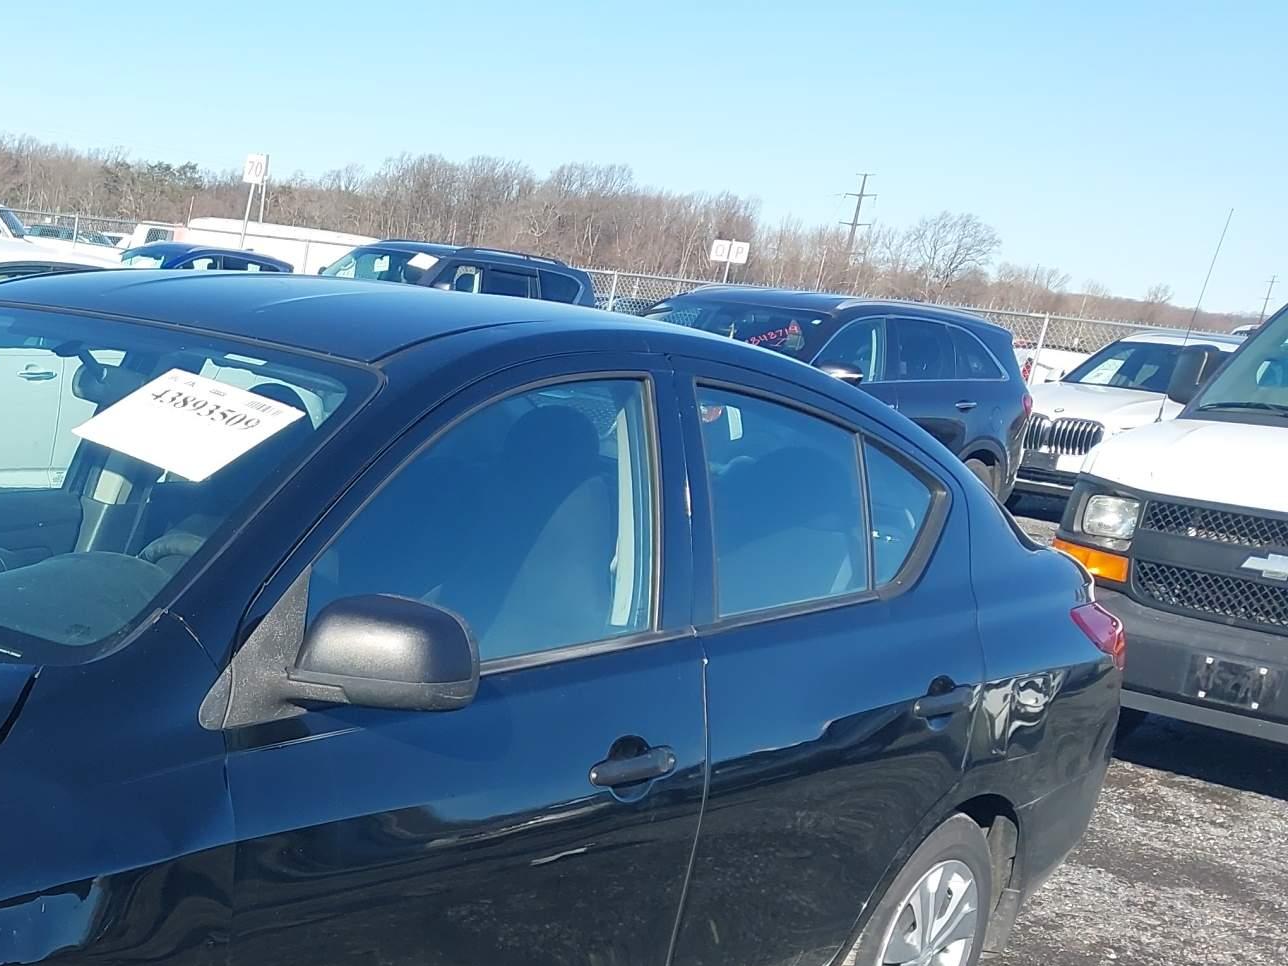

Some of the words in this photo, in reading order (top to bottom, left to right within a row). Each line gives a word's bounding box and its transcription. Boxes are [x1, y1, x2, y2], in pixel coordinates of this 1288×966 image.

[247, 160, 263, 178] 70
[734, 246, 744, 259] P
[151, 388, 261, 430] 43893509
